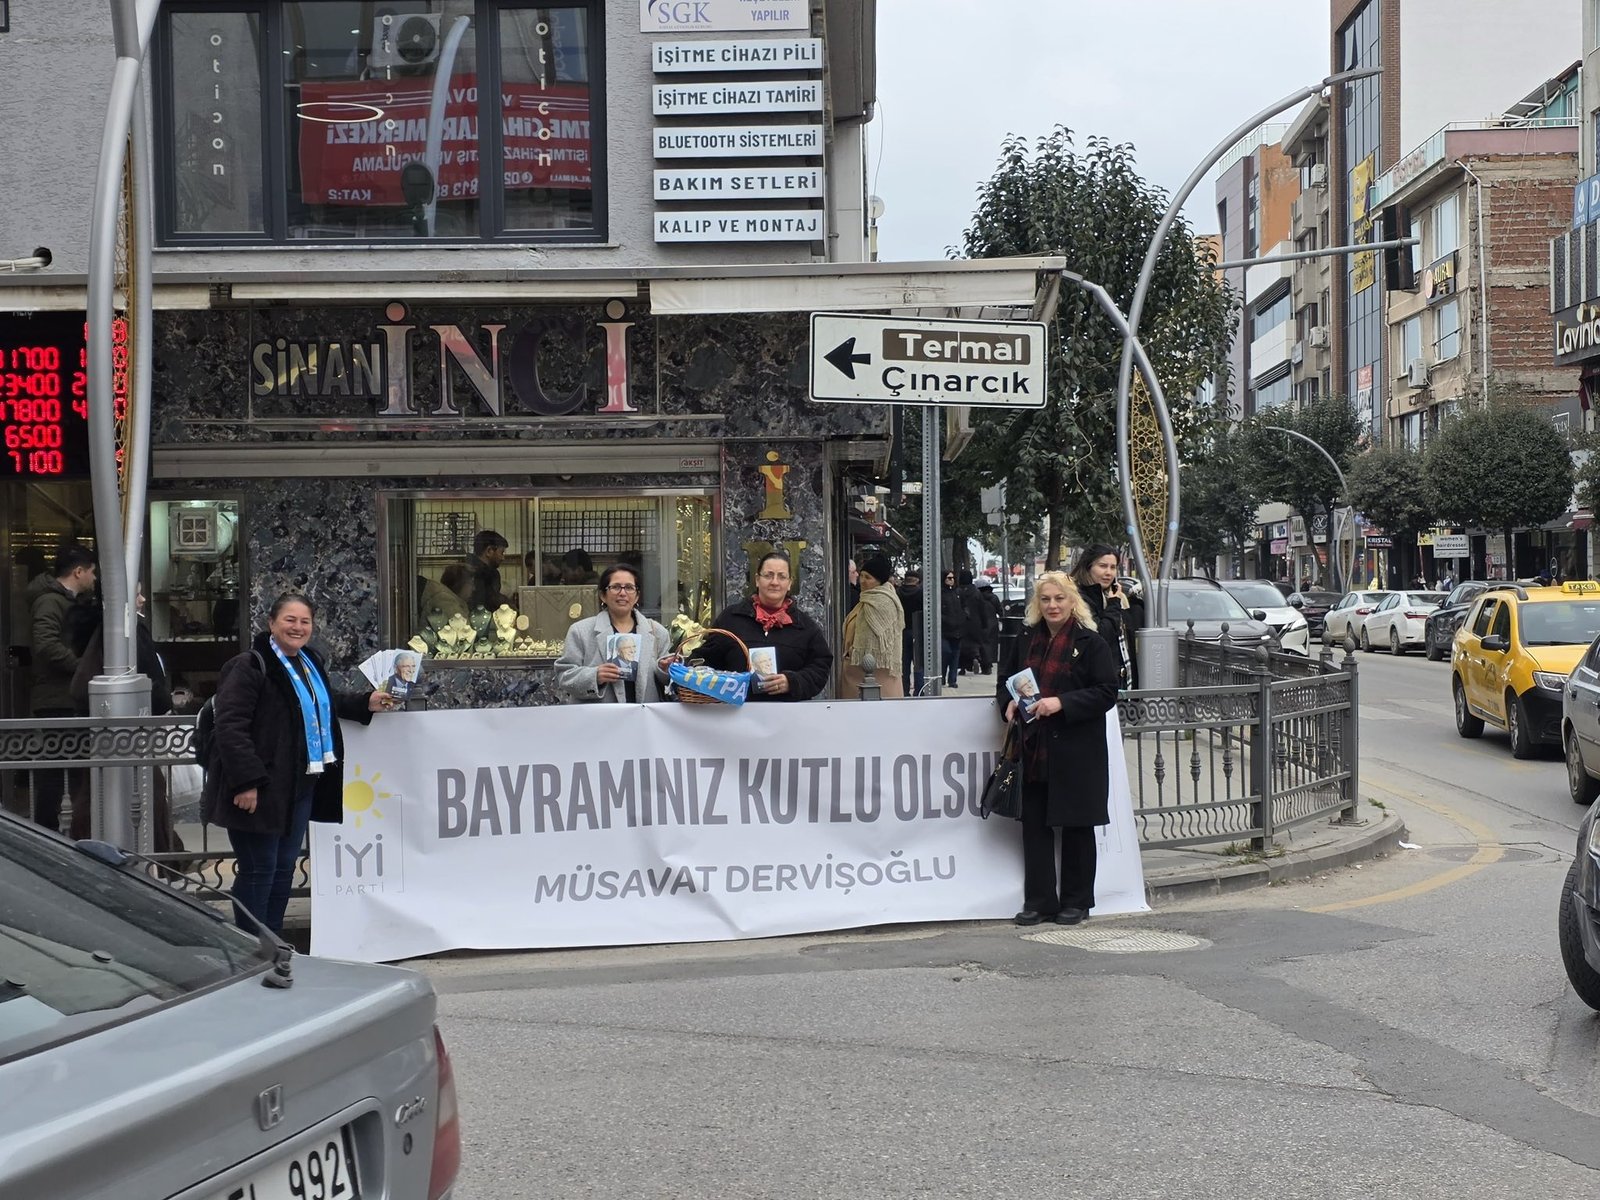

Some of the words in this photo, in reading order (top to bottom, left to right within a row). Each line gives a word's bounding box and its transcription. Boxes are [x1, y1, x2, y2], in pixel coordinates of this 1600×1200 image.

[658, 2, 712, 24] SGK
[751, 10, 789, 21] YAPILIR
[658, 47, 715, 66] İŞİTME
[721, 45, 777, 62] CİHAZI
[783, 43, 816, 60] PİLİ
[658, 89, 708, 109] İŞİTME
[712, 88, 761, 104] CİHAZI
[766, 86, 816, 103] TAMİRİ
[658, 135, 735, 149] BLUETOOTH
[739, 130, 816, 147] SİSTEMLERİ
[659, 177, 723, 191] BAKIM
[730, 172, 817, 190] SETLERİ
[659, 220, 712, 233] KALIP
[718, 220, 740, 233] VE
[746, 218, 817, 232] MONTAJ
[376, 302, 638, 416] İNCİ
[898, 333, 1023, 362] Termal
[881, 367, 1030, 397] Çınarcık
[5, 424, 62, 448] 6500
[8, 450, 63, 473] 7100
[438, 757, 728, 839] BAYRAMINIZ
[739, 755, 882, 826] KUTLU
[334, 833, 384, 878] İYİ
[534, 864, 718, 904] MÜSAVAT
[726, 850, 957, 896] DERVİŞOĞLU
